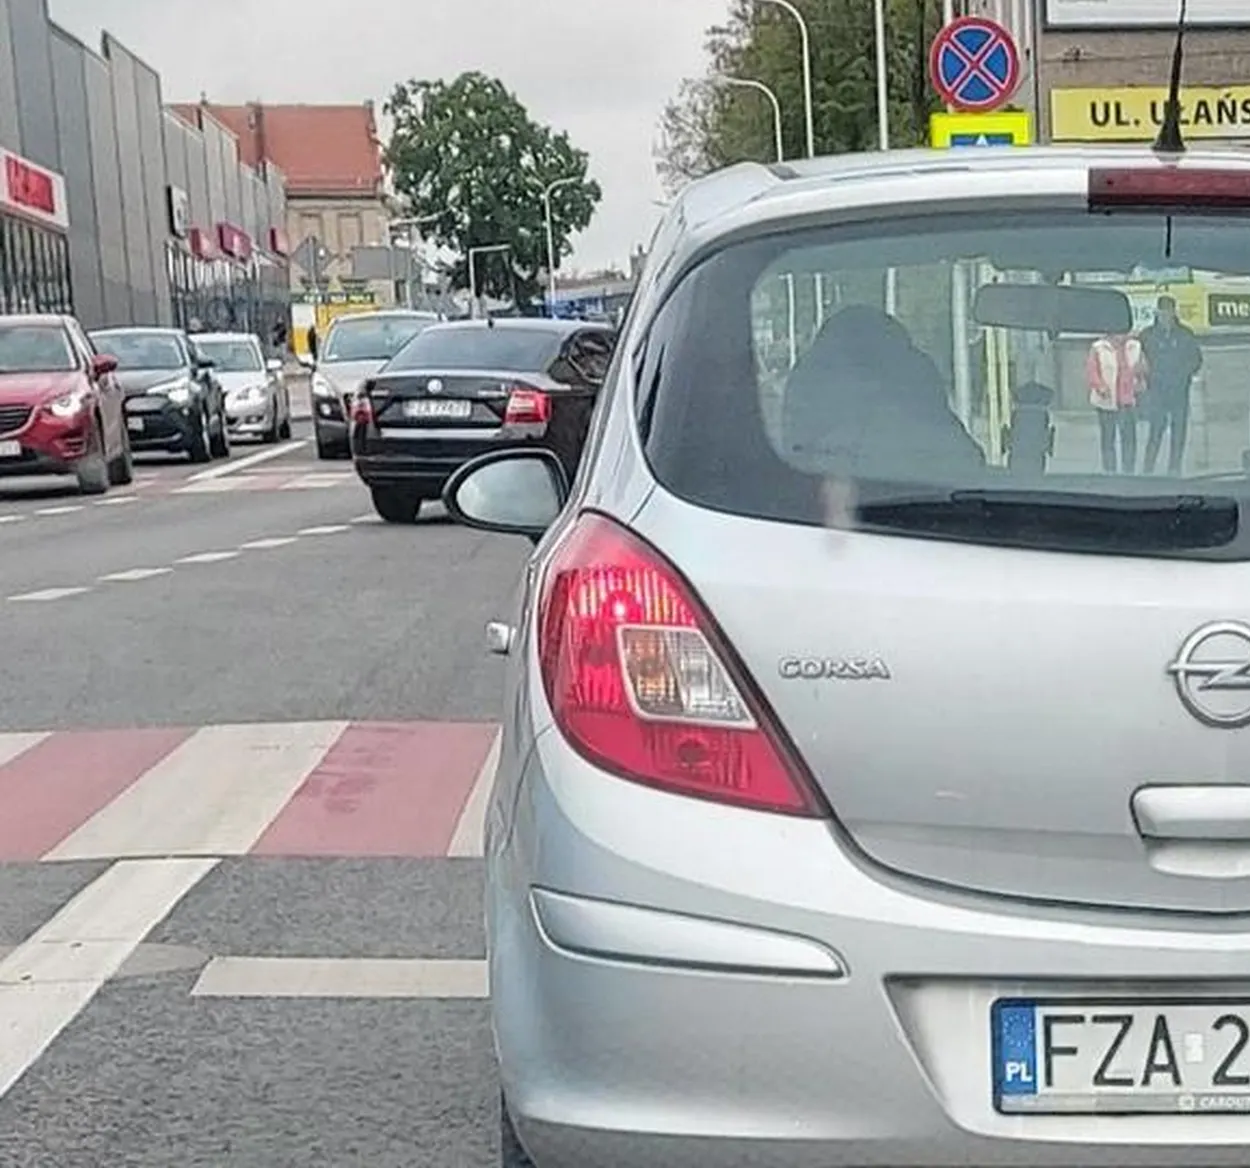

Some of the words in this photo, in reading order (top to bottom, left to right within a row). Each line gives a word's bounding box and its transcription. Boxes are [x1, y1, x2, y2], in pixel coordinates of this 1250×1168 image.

[1090, 99, 1141, 127] UL.
[778, 657, 891, 680] CORSA
[1043, 1014, 1182, 1087] FZA
[1005, 1063, 1033, 1082] PL
